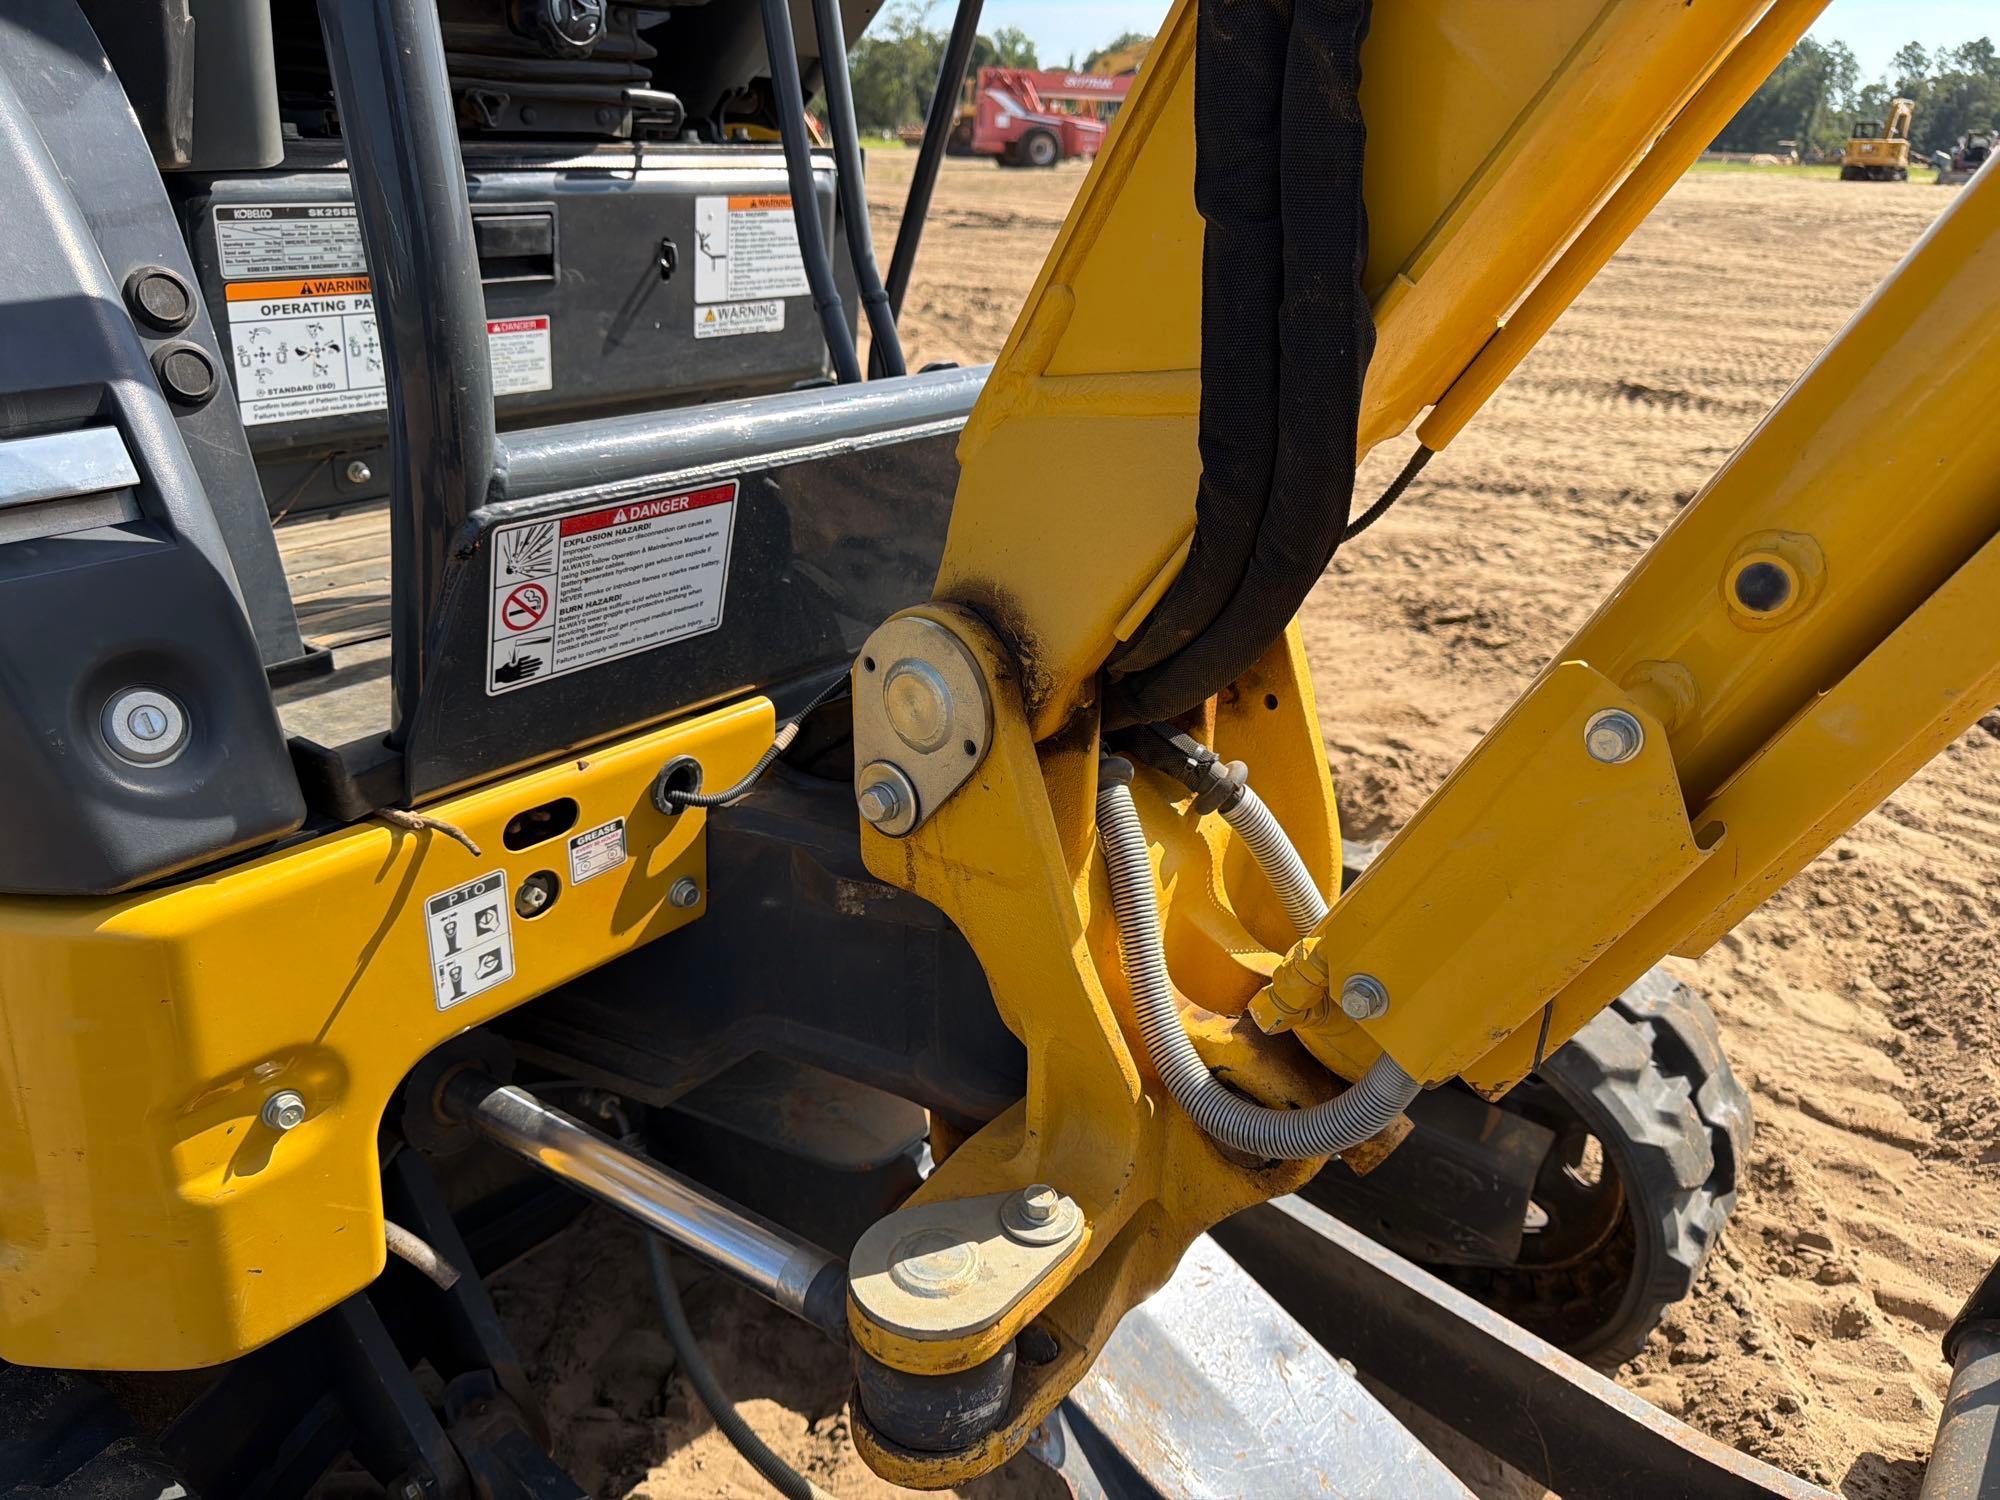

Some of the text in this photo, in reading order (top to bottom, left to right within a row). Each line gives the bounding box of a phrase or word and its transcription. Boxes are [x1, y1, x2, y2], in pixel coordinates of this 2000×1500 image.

[233, 209, 272, 218] KOBELCO
[259, 300, 346, 316] OPERATING
[718, 303, 777, 319] WARNING
[500, 320, 536, 331] DANGER
[267, 384, 313, 395] STANDARD
[252, 401, 279, 411] Confirm
[339, 392, 363, 402] Change
[254, 411, 280, 420] Failure
[629, 495, 689, 520] DANGER
[562, 544, 591, 557] Improper
[592, 536, 626, 549] connection
[634, 525, 674, 539] disconnection
[563, 521, 651, 547] EXPLOSION HAZARD!
[561, 560, 590, 571] ALWAYS
[591, 555, 609, 564] follow
[611, 548, 640, 561] Operation
[647, 538, 682, 551] Maintenance
[683, 534, 704, 543] Manual
[704, 530, 719, 538] when
[562, 552, 593, 565] explosion.
[560, 577, 582, 589] Battery
[582, 570, 613, 584] generates
[615, 563, 643, 576] hydrogen
[656, 556, 672, 564] which
[684, 547, 706, 558] explode
[561, 559, 626, 581] using booster cables.
[559, 593, 582, 603] NEVER
[583, 587, 604, 597] smoke
[613, 578, 640, 590] introduce
[641, 573, 660, 582] flames
[668, 567, 687, 577] sparks
[701, 558, 721, 569] battery.
[560, 585, 582, 596] ignited.
[558, 612, 580, 624] Battery
[581, 605, 608, 617] contains
[609, 599, 630, 610] sulfuric
[632, 596, 644, 604] acid
[645, 591, 662, 600] which
[558, 587, 702, 630] ALWAYS wear goggle and protective clothing when
[559, 593, 622, 615] BURN HAZARD!
[557, 636, 574, 645] Flush
[575, 632, 588, 640] with
[589, 627, 606, 636] water
[607, 624, 619, 632] and
[619, 621, 628, 630] get
[629, 615, 650, 627] prompt
[651, 609, 672, 619] medical
[673, 602, 698, 613] treatment
[557, 619, 608, 639] servicing battery.
[556, 653, 576, 664] Failure
[585, 645, 606, 657] comply
[607, 642, 618, 650] will
[619, 637, 635, 646] result
[642, 630, 658, 640] death
[666, 622, 686, 633] serious
[556, 642, 579, 653] contact
[581, 635, 601, 646] should
[576, 822, 616, 846] GREASE
[448, 883, 485, 906] PTO
